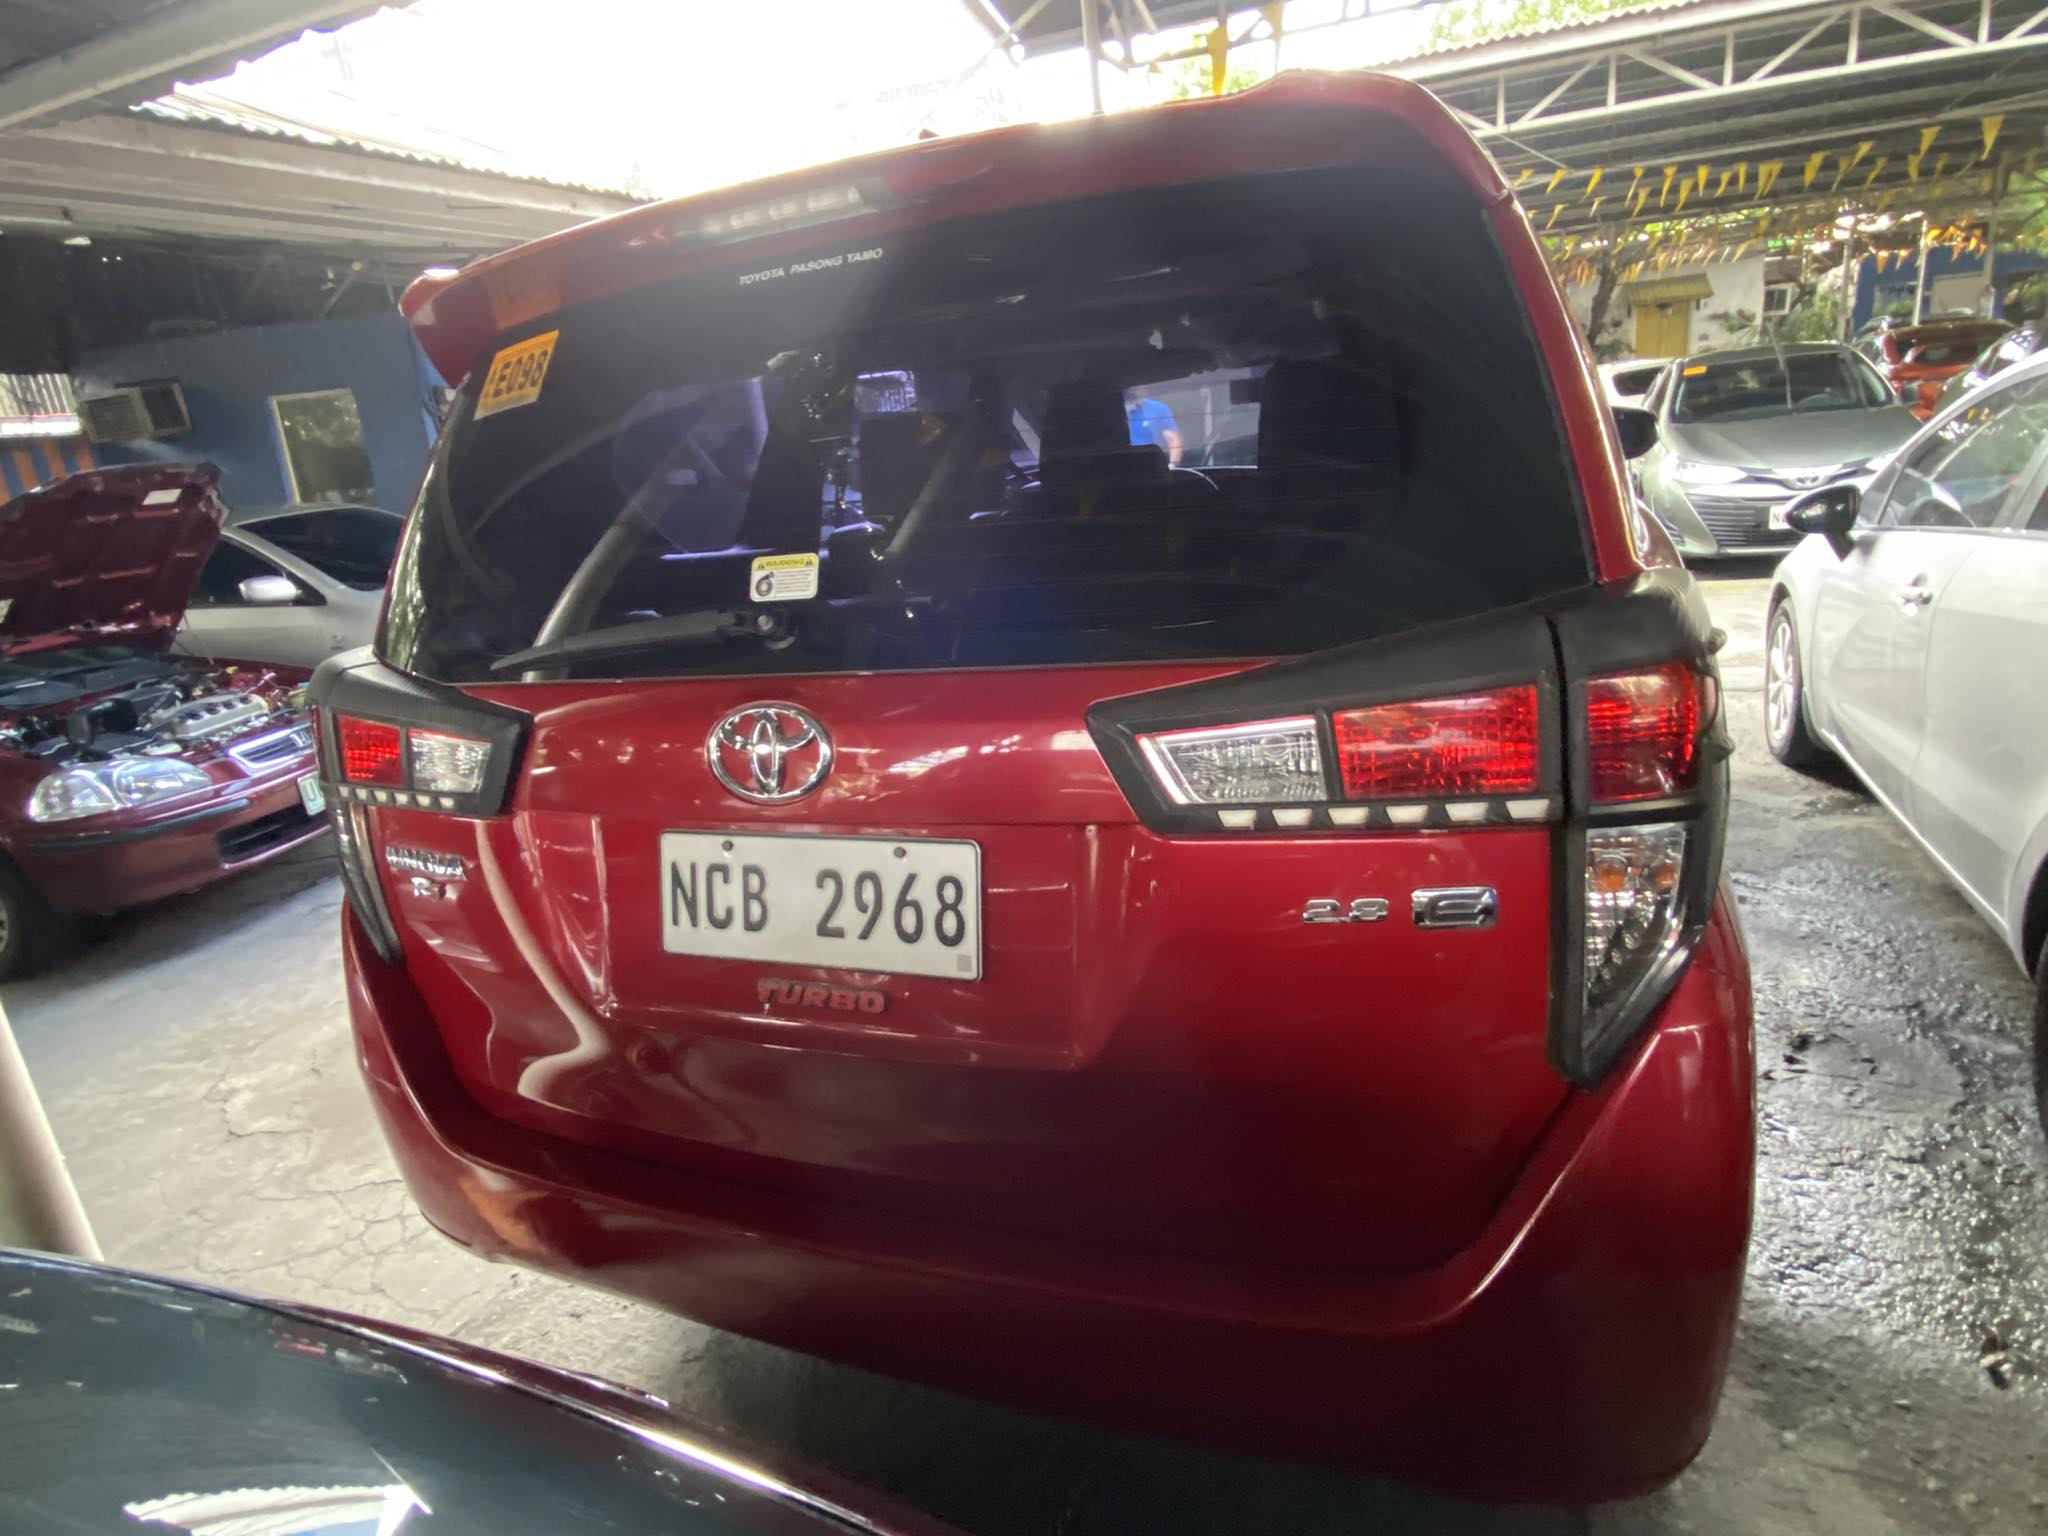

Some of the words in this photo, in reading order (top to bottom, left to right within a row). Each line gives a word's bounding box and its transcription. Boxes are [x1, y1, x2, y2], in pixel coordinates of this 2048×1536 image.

[738, 267, 785, 286] TOYOTA
[790, 255, 843, 275] PASONG
[846, 247, 884, 263] TAMO
[491, 348, 549, 398] E098
[671, 860, 768, 933] NCB
[815, 868, 967, 948] 2968
[1302, 897, 1390, 924] 2.8
[757, 977, 887, 1014] TURBO
